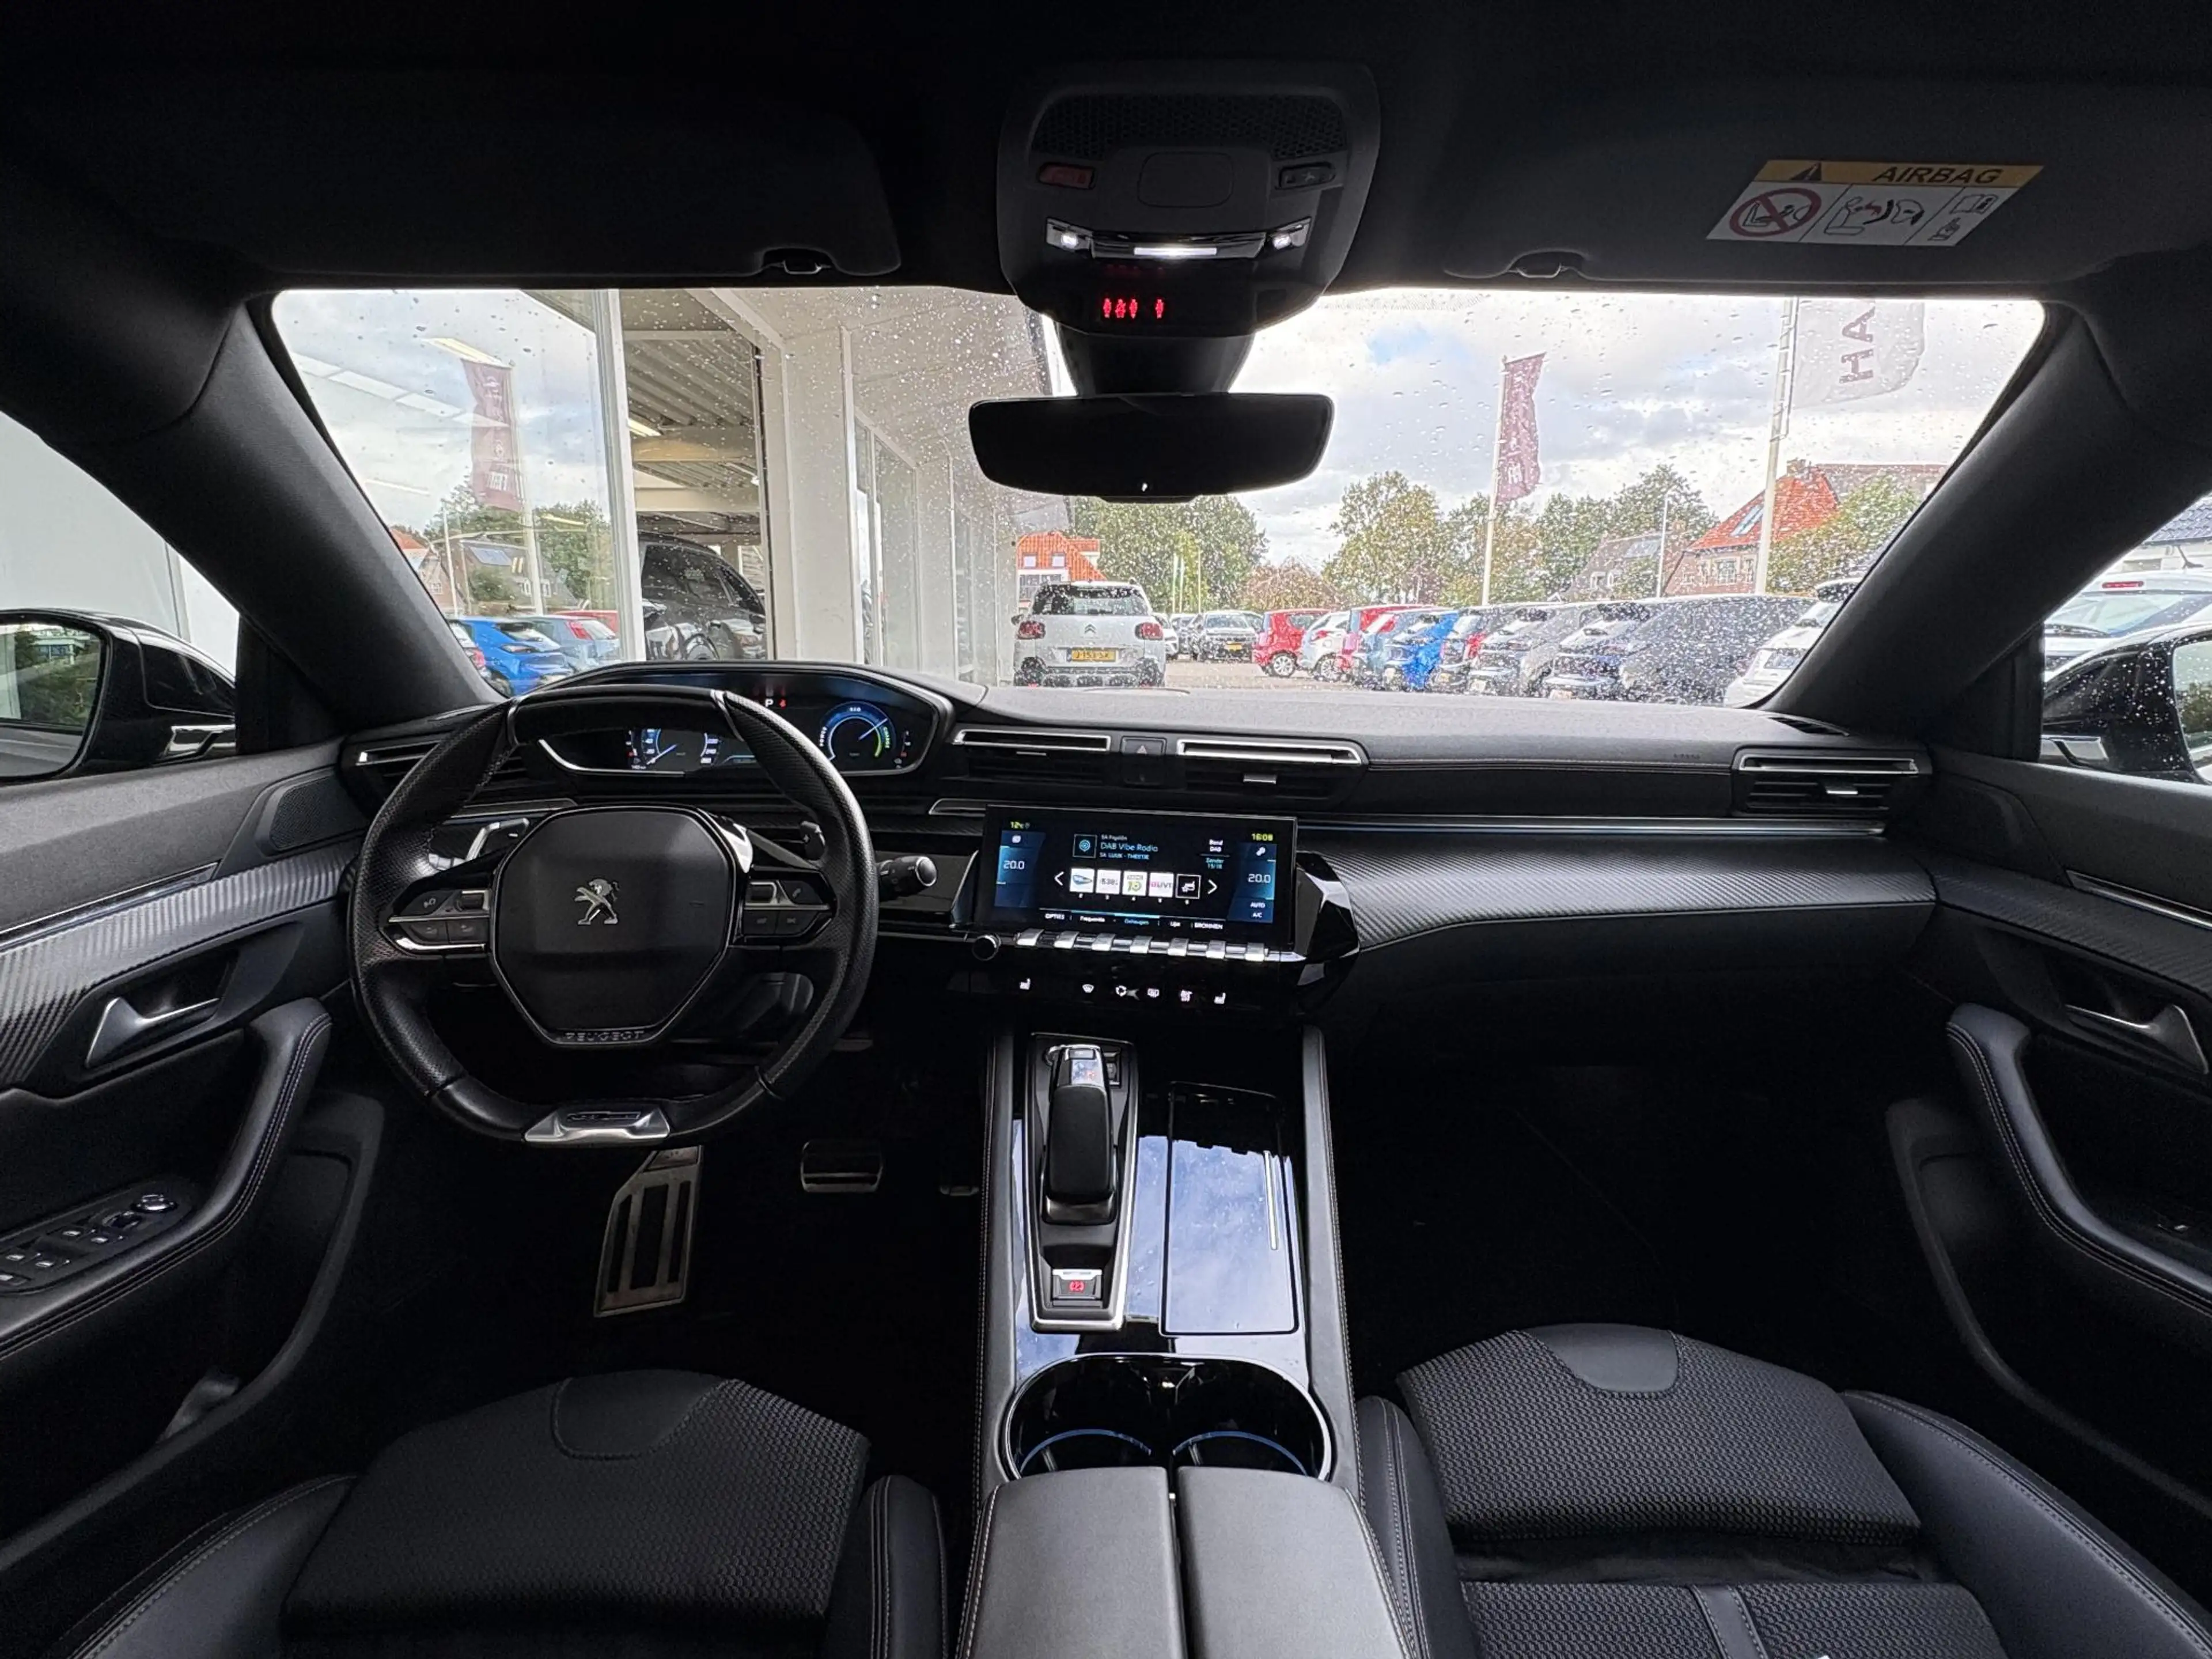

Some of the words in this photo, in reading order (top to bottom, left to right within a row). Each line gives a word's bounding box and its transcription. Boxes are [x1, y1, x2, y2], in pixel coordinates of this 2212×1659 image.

[1872, 166, 2005, 184] AIRBAG
[764, 699, 774, 707] P
[819, 726, 828, 748] POWER
[1100, 842, 1117, 850] DAB
[1119, 843, 1135, 851] Vibe
[1137, 843, 1159, 852] Radio
[1003, 860, 1025, 869] 20.0
[1247, 873, 1271, 884] 20.0
[565, 1030, 645, 1041] PEUGEOT
